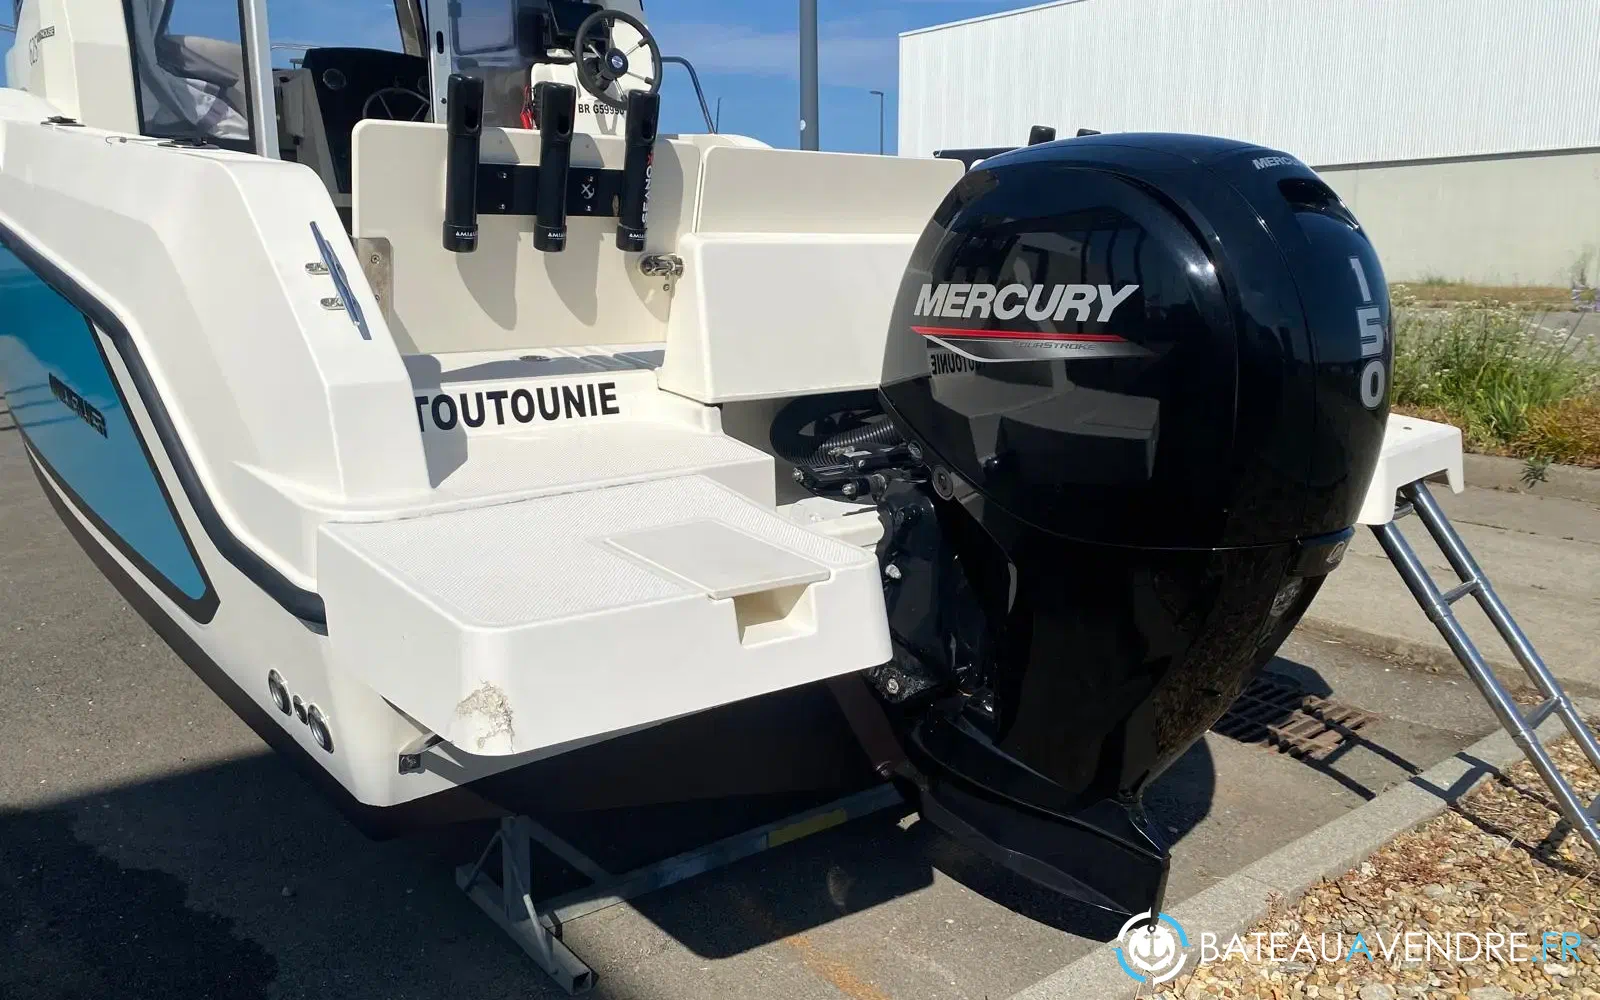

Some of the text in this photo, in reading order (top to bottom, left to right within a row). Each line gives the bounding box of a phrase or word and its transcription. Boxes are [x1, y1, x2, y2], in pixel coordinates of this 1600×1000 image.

[578, 103, 591, 114] BR
[913, 283, 1140, 323] MERCURY
[1350, 256, 1387, 412] 150
[414, 381, 620, 432] TOUTOUNIE
